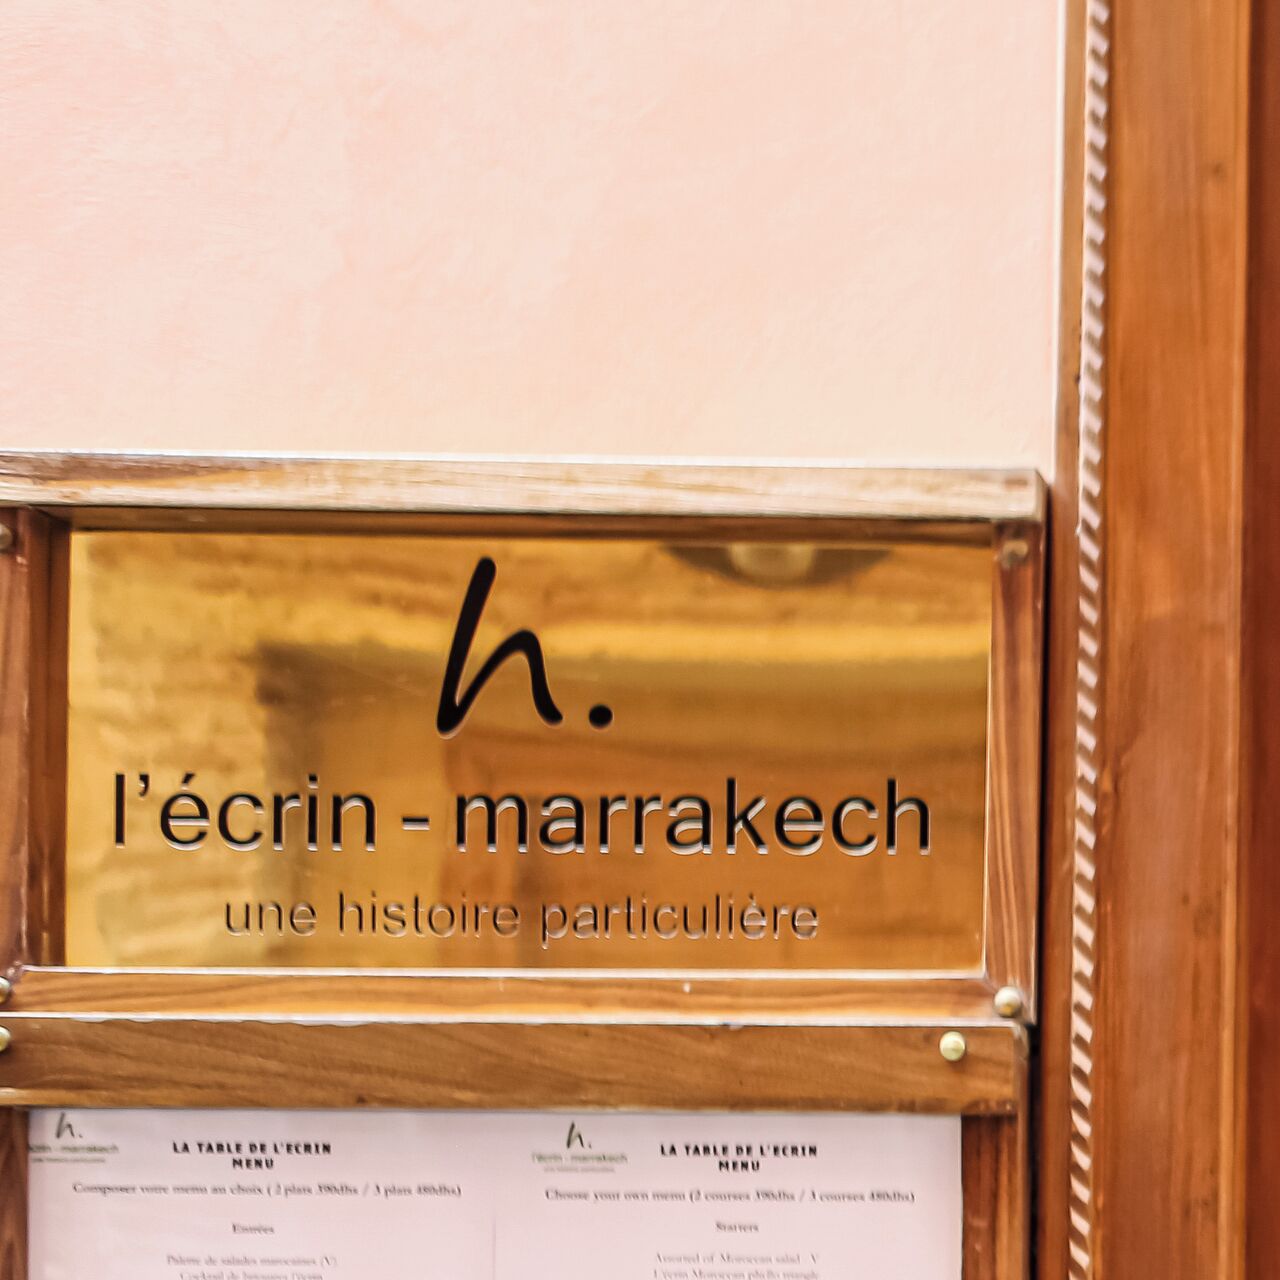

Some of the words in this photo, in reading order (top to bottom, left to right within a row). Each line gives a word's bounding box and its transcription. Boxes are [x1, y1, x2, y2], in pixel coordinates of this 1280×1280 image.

[437, 556, 613, 737] h.
[112, 773, 378, 853] l'écrin
[402, 814, 430, 833] -
[455, 776, 931, 857] marrakech
[223, 898, 317, 938] une
[338, 891, 522, 941] histoire
[541, 891, 820, 949] particulière
[172, 1141, 190, 1154] LA
[196, 1141, 242, 1154] TABLE
[249, 1141, 267, 1154] DE
[273, 1141, 332, 1154] L'ECRIN
[660, 1144, 677, 1156] LA
[684, 1144, 728, 1156] TABLE
[736, 1144, 752, 1156] DE
[760, 1144, 817, 1156] L'ECRIN
[232, 1158, 274, 1170] MENU
[719, 1160, 759, 1171] MENU
[73, 1183, 136, 1197] Composer
[172, 1186, 208, 1194] menu
[211, 1186, 226, 1194] au
[230, 1183, 263, 1194] choix
[545, 1190, 588, 1200] Choose
[592, 1192, 620, 1203] your
[624, 1192, 648, 1200] own
[652, 1192, 686, 1200] menu
[704, 1192, 750, 1200] courses
[820, 1192, 865, 1200] courses
